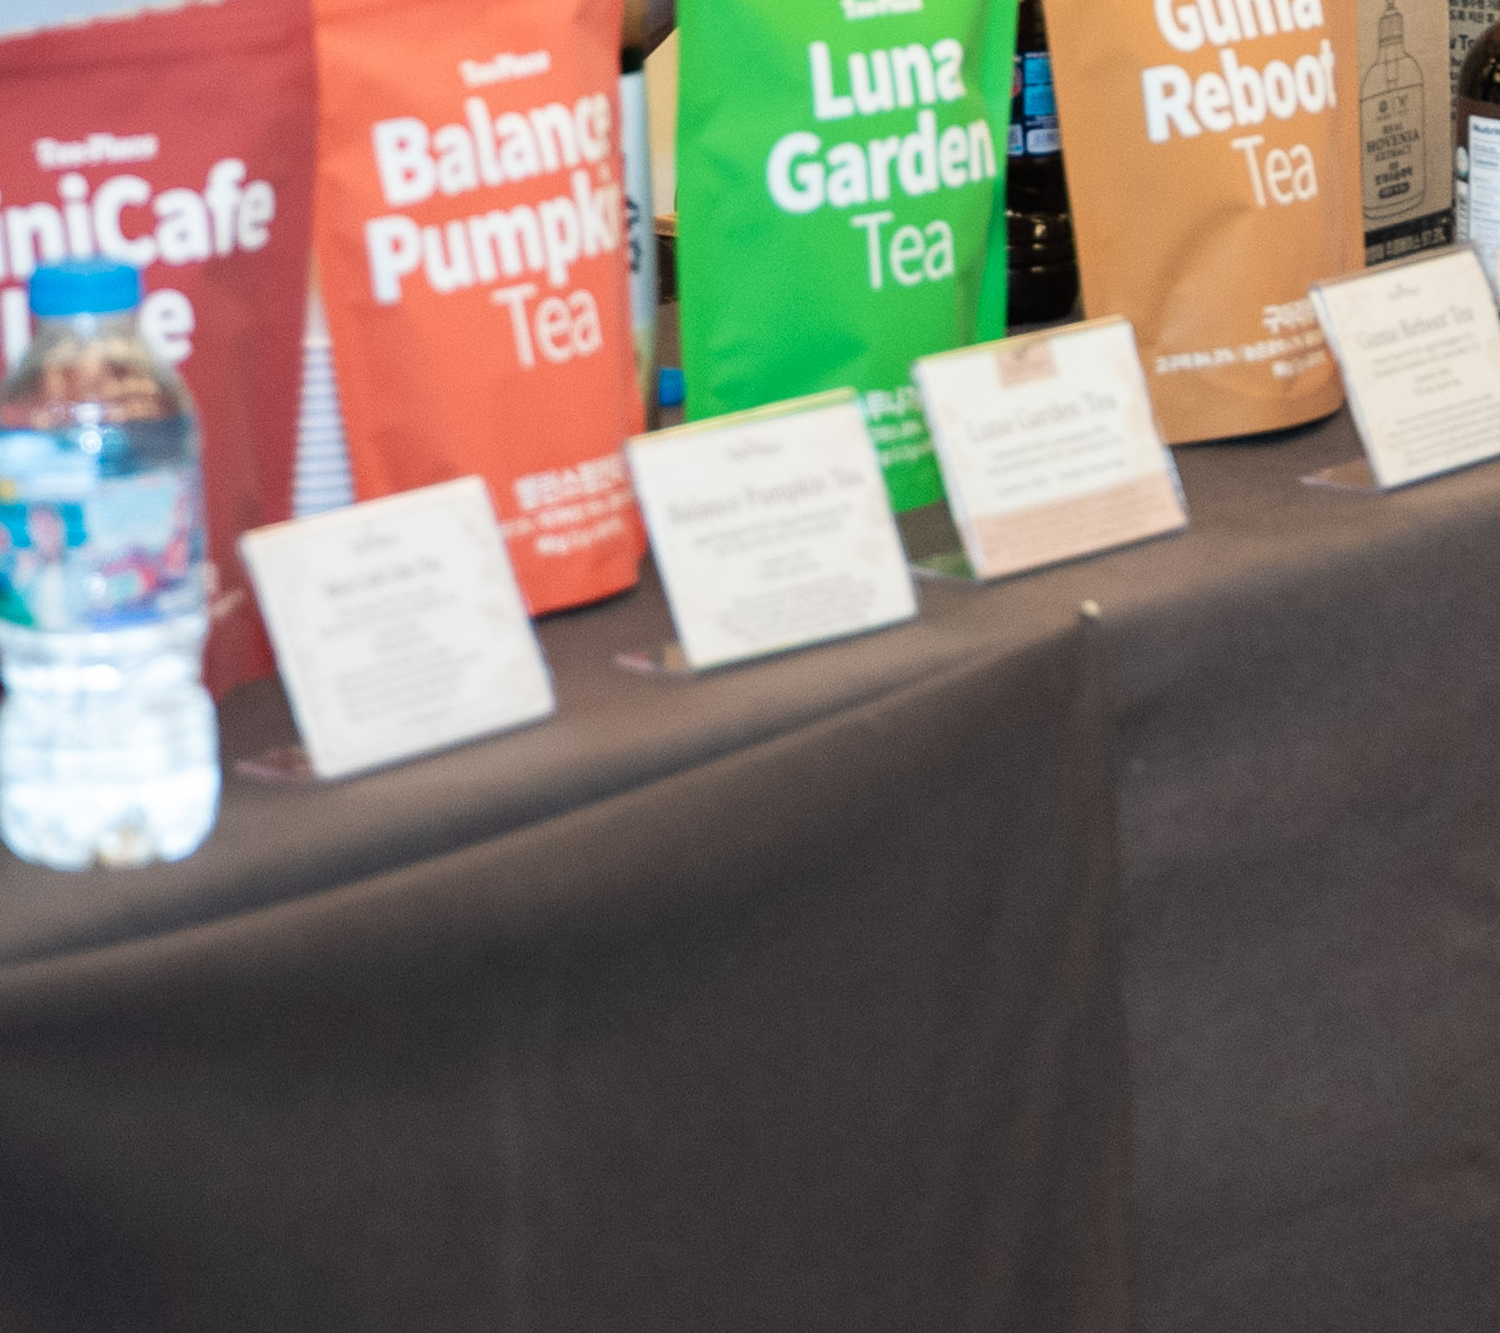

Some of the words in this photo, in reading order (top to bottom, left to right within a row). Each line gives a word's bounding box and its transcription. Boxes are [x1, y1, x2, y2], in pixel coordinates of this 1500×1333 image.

[809, 35, 968, 122] Luna
[1141, 38, 1338, 144] Reboot
[766, 112, 998, 215] Garden
[1231, 135, 1320, 210] Tea
[852, 210, 955, 290] Tea
[492, 286, 603, 371] Tea
